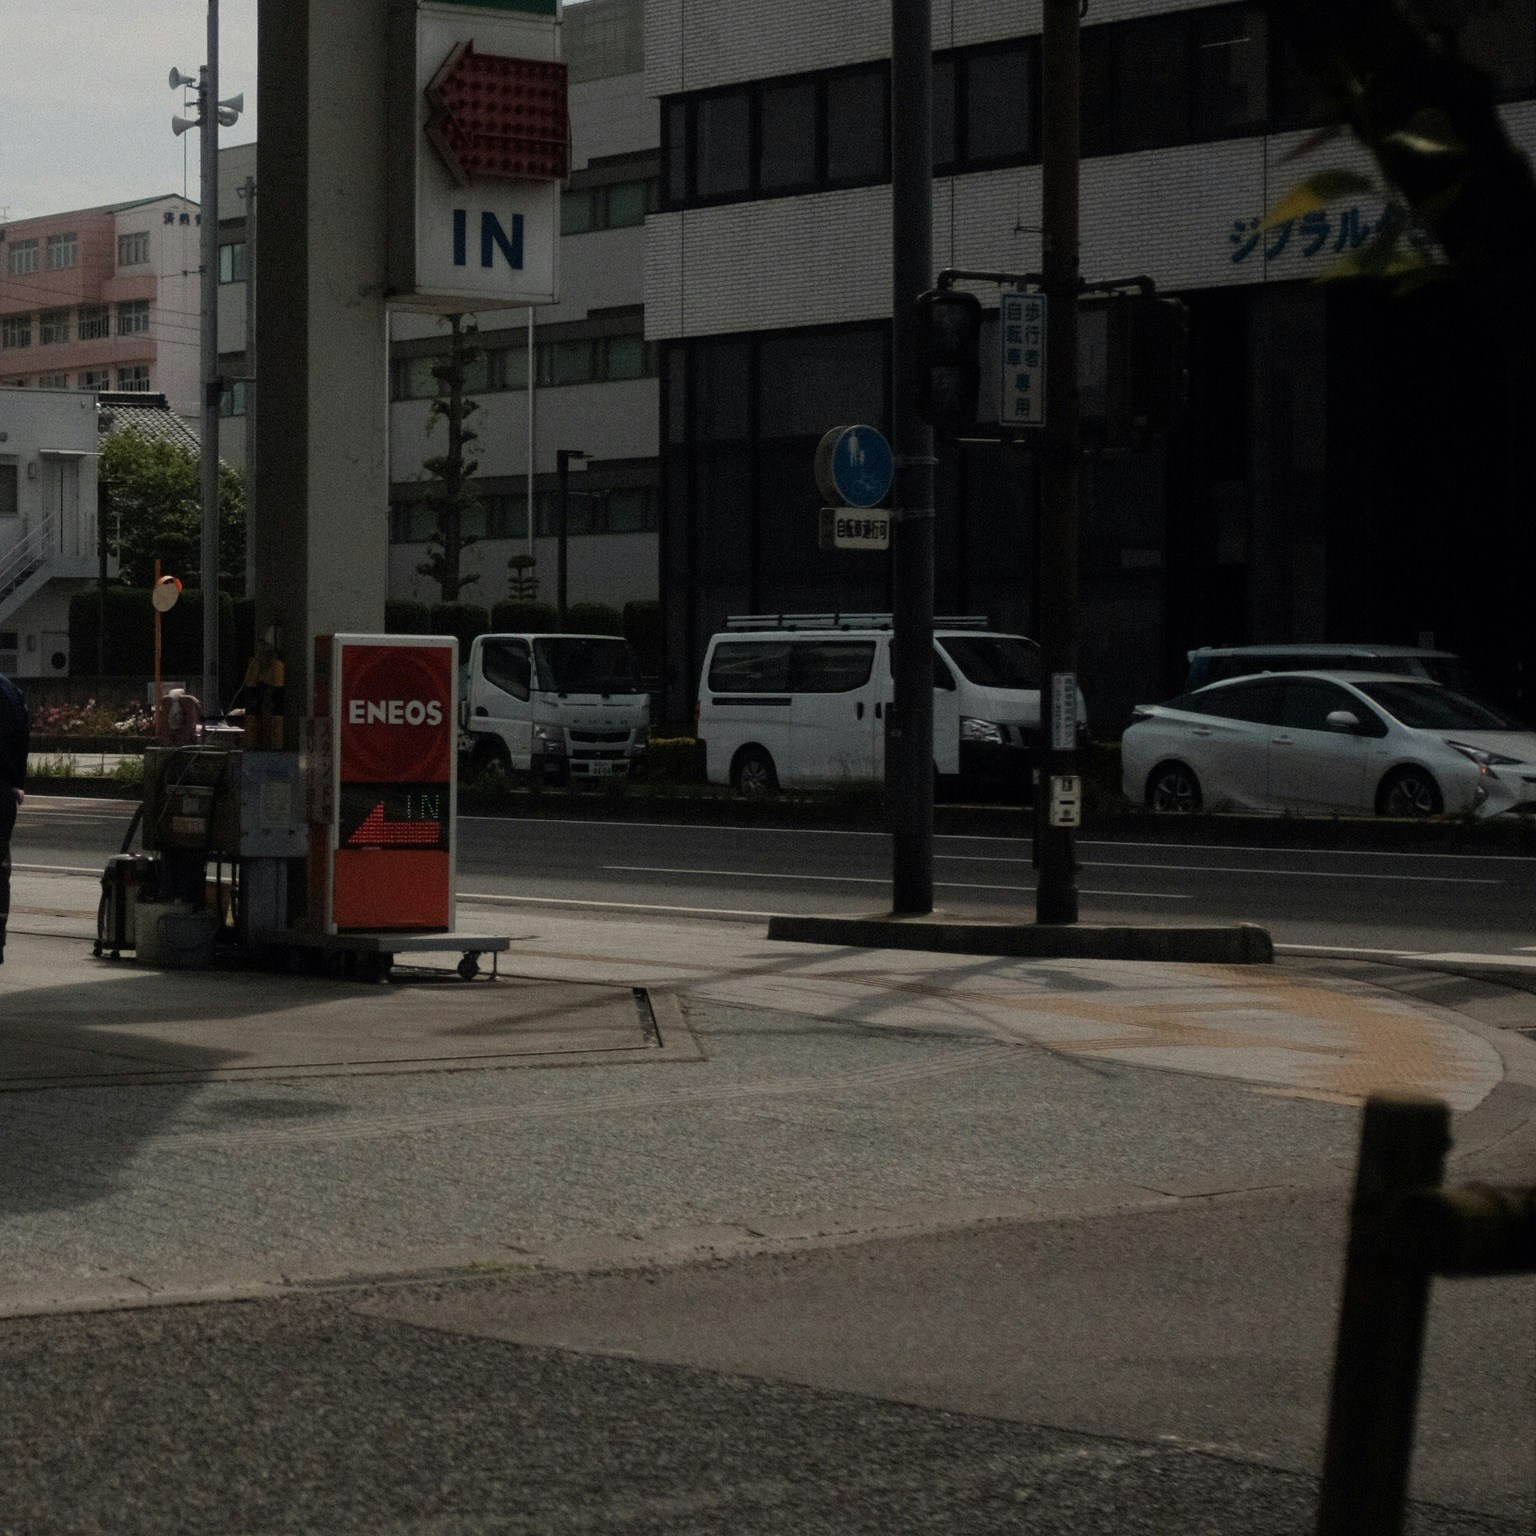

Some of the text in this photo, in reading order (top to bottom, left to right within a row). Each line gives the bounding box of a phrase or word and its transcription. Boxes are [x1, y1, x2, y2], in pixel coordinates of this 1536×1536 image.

[453, 209, 524, 271] IN
[348, 699, 443, 726] ENEOS
[406, 794, 439, 819] IN
